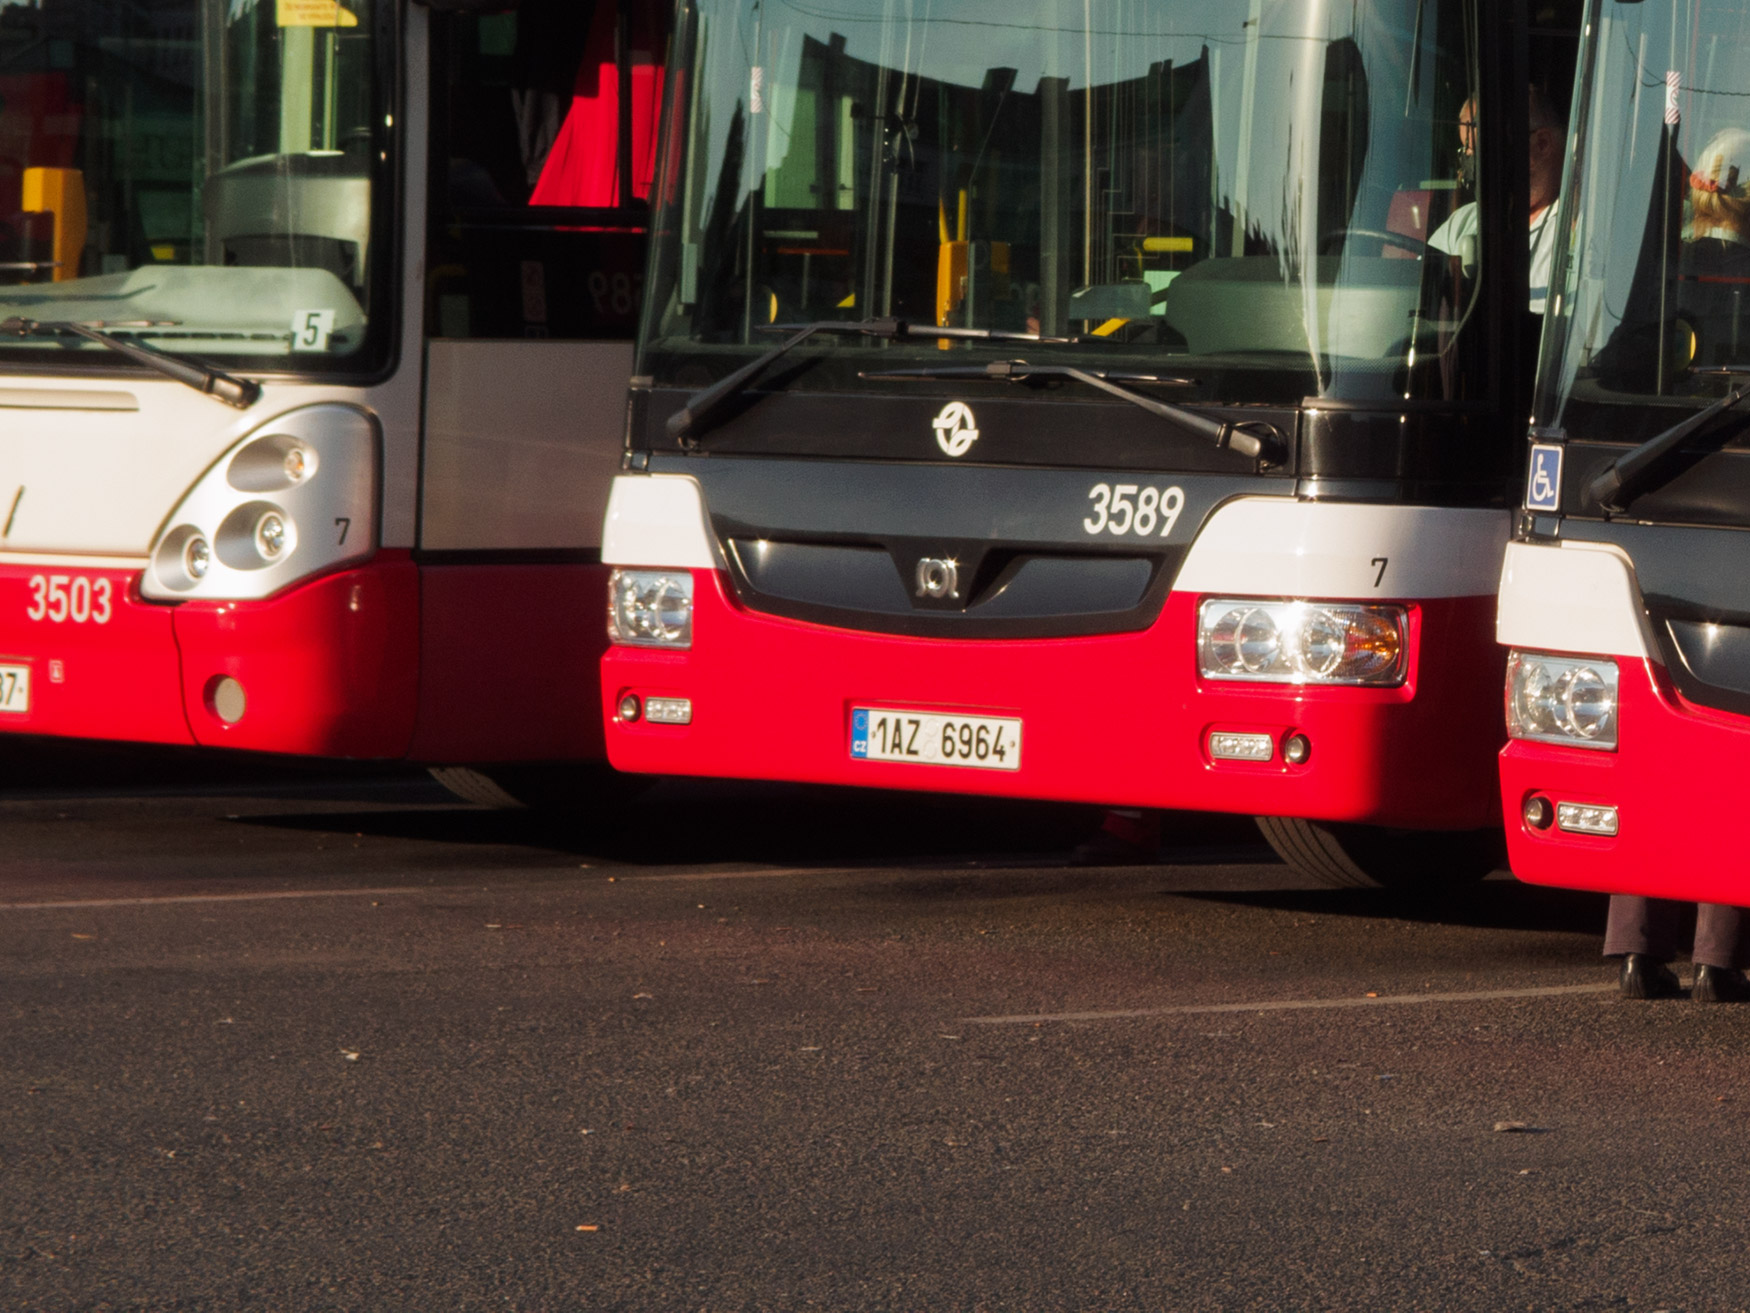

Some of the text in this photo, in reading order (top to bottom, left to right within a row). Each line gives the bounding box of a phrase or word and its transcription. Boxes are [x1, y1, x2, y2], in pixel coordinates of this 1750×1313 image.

[303, 313, 321, 346] 5
[1083, 482, 1185, 537] 3589
[335, 517, 350, 546] 7
[1371, 557, 1389, 588] 7
[26, 574, 112, 624] 3503
[853, 717, 1006, 762] CZ 1AZ 6964
